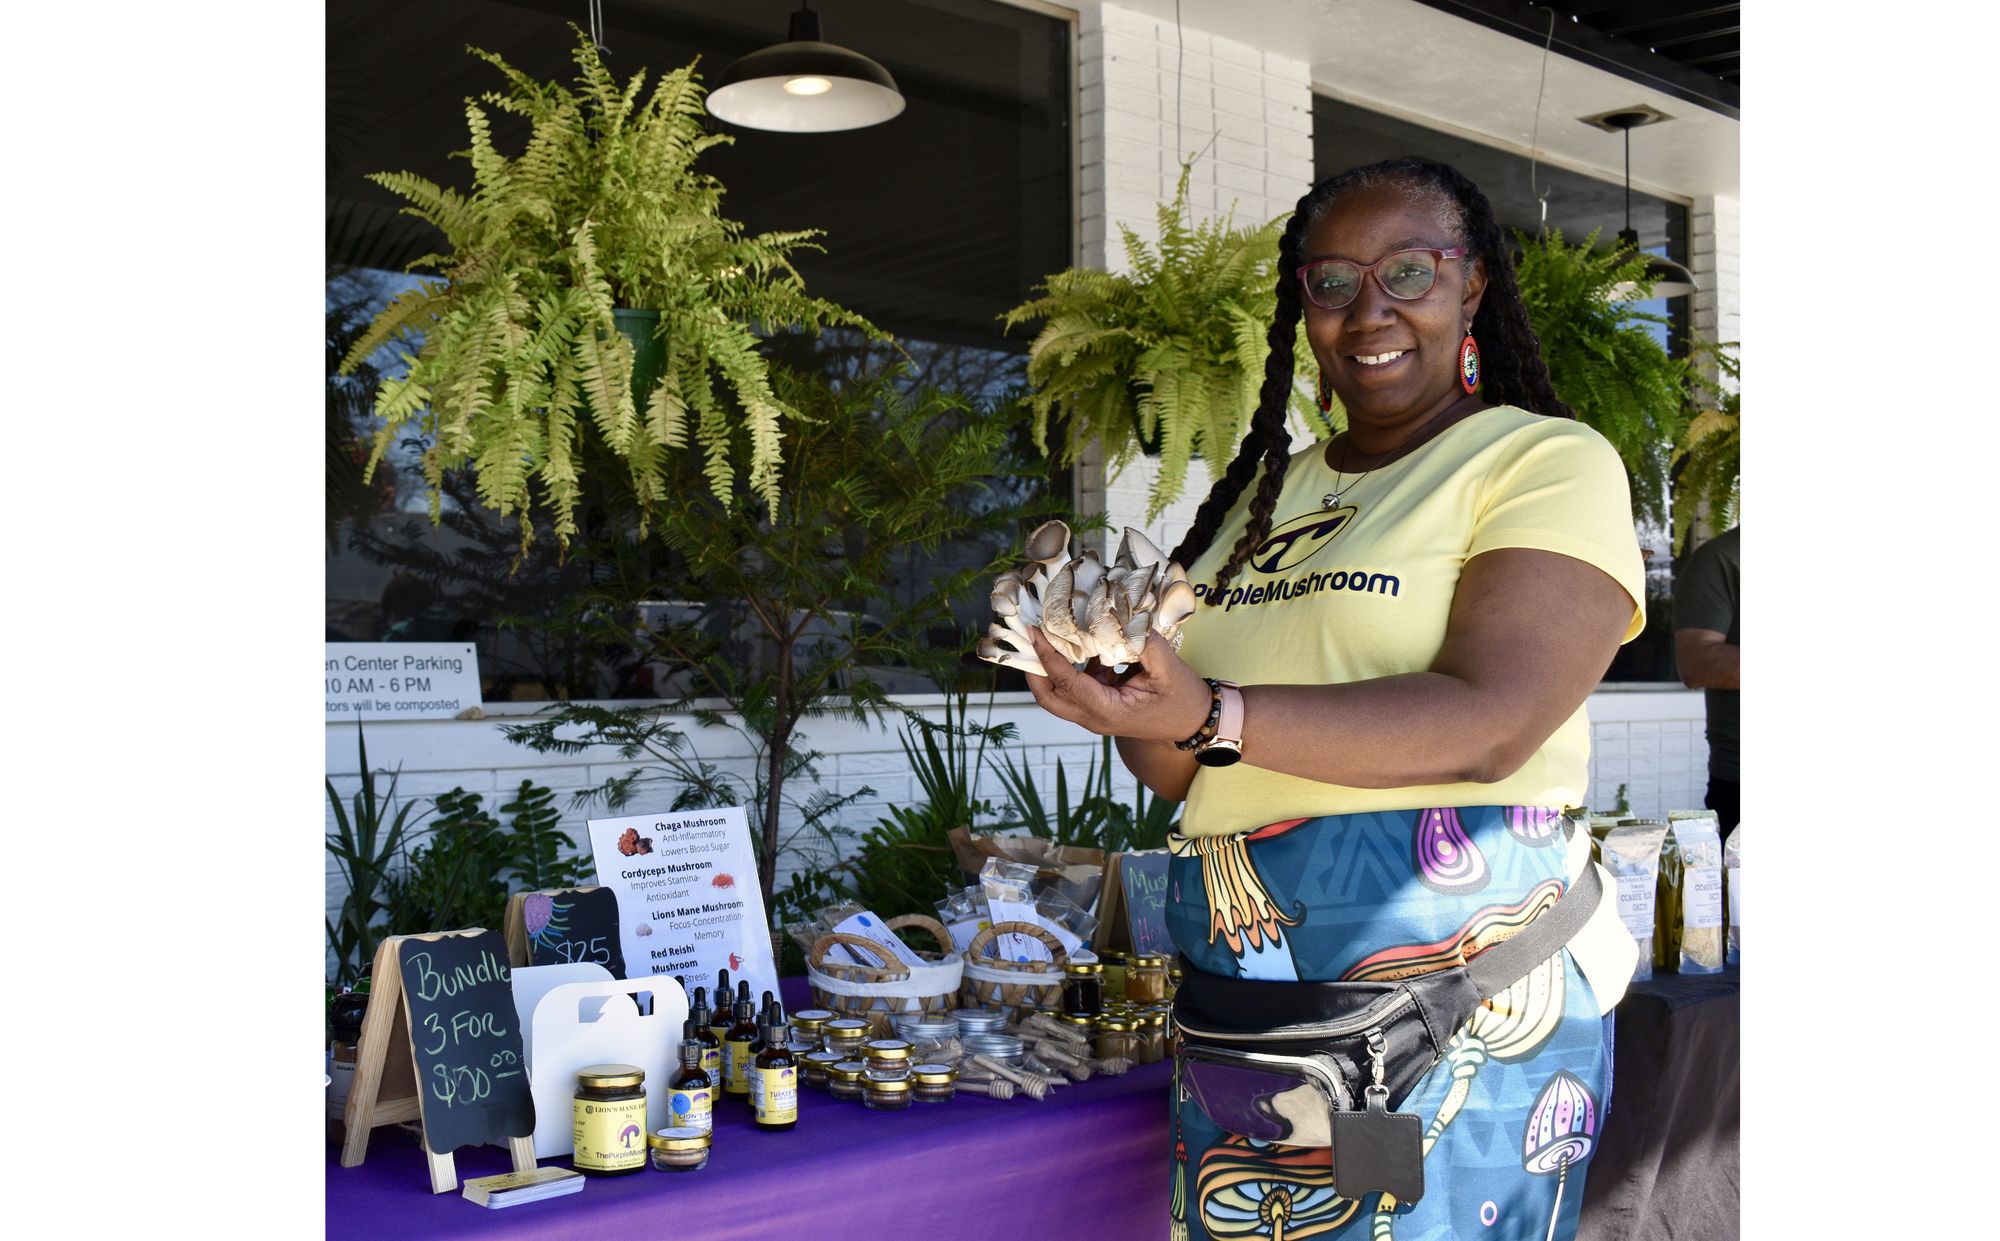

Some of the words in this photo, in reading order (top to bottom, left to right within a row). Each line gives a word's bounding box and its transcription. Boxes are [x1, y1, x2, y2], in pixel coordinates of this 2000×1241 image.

[344, 655, 399, 671] Center
[404, 656, 463, 673] Parking
[347, 678, 374, 693] AM
[390, 677, 400, 692] 6
[405, 678, 431, 692] PM
[352, 700, 372, 711] will
[375, 700, 391, 711] be
[394, 699, 460, 712] composted
[655, 819, 682, 832] Chaga
[683, 816, 727, 829] Mushroom
[662, 829, 726, 844] Anti-Inflammatory
[660, 846, 689, 857] Lowers
[689, 844, 710, 854] Blood
[710, 841, 731, 853] Sugar
[621, 866, 666, 880] Cordyceps
[667, 860, 713, 874] Mushroom
[631, 878, 667, 891] Improves
[667, 873, 701, 886] Stamina-
[646, 889, 690, 903] Antioxidant
[651, 910, 676, 922] Lions
[676, 906, 701, 918] Mane
[701, 899, 745, 914] Mushroom
[694, 928, 725, 941] Memory
[556, 936, 610, 965] $25
[650, 948, 668, 960] Red
[669, 943, 695, 957] Reishi
[652, 960, 699, 975] Mushroom
[684, 973, 710, 984] Stress-
[424, 1013, 447, 1055] 3
[619, 1104, 638, 1112] MANE
